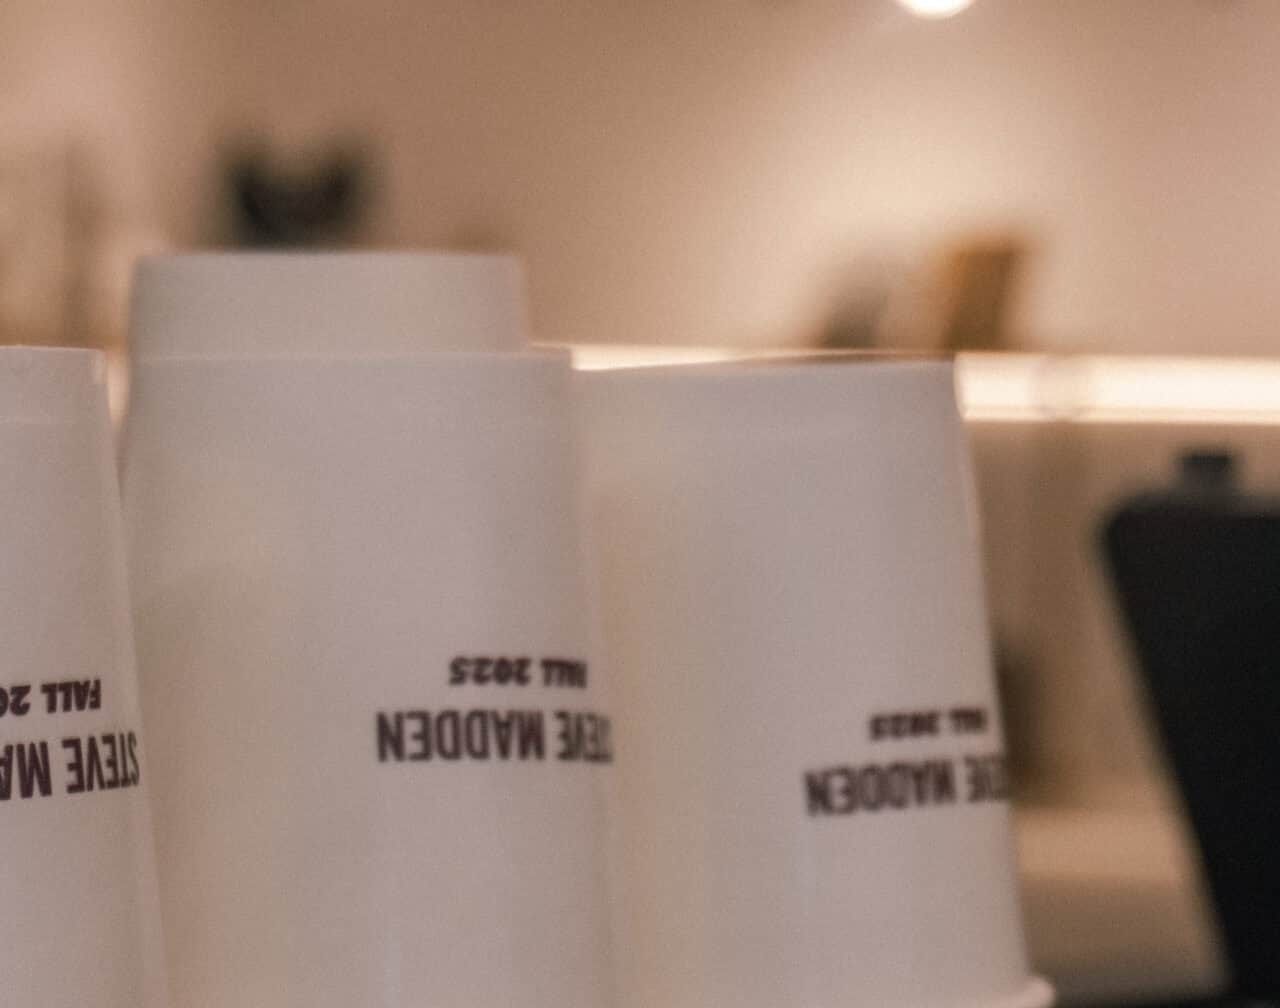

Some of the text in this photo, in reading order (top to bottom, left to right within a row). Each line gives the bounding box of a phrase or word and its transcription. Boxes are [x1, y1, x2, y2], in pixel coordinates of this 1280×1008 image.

[448, 656, 531, 686] 2025
[40, 678, 102, 714] FALL
[376, 709, 613, 763] TEVE MADDEN
[61, 730, 140, 794] STEVE
